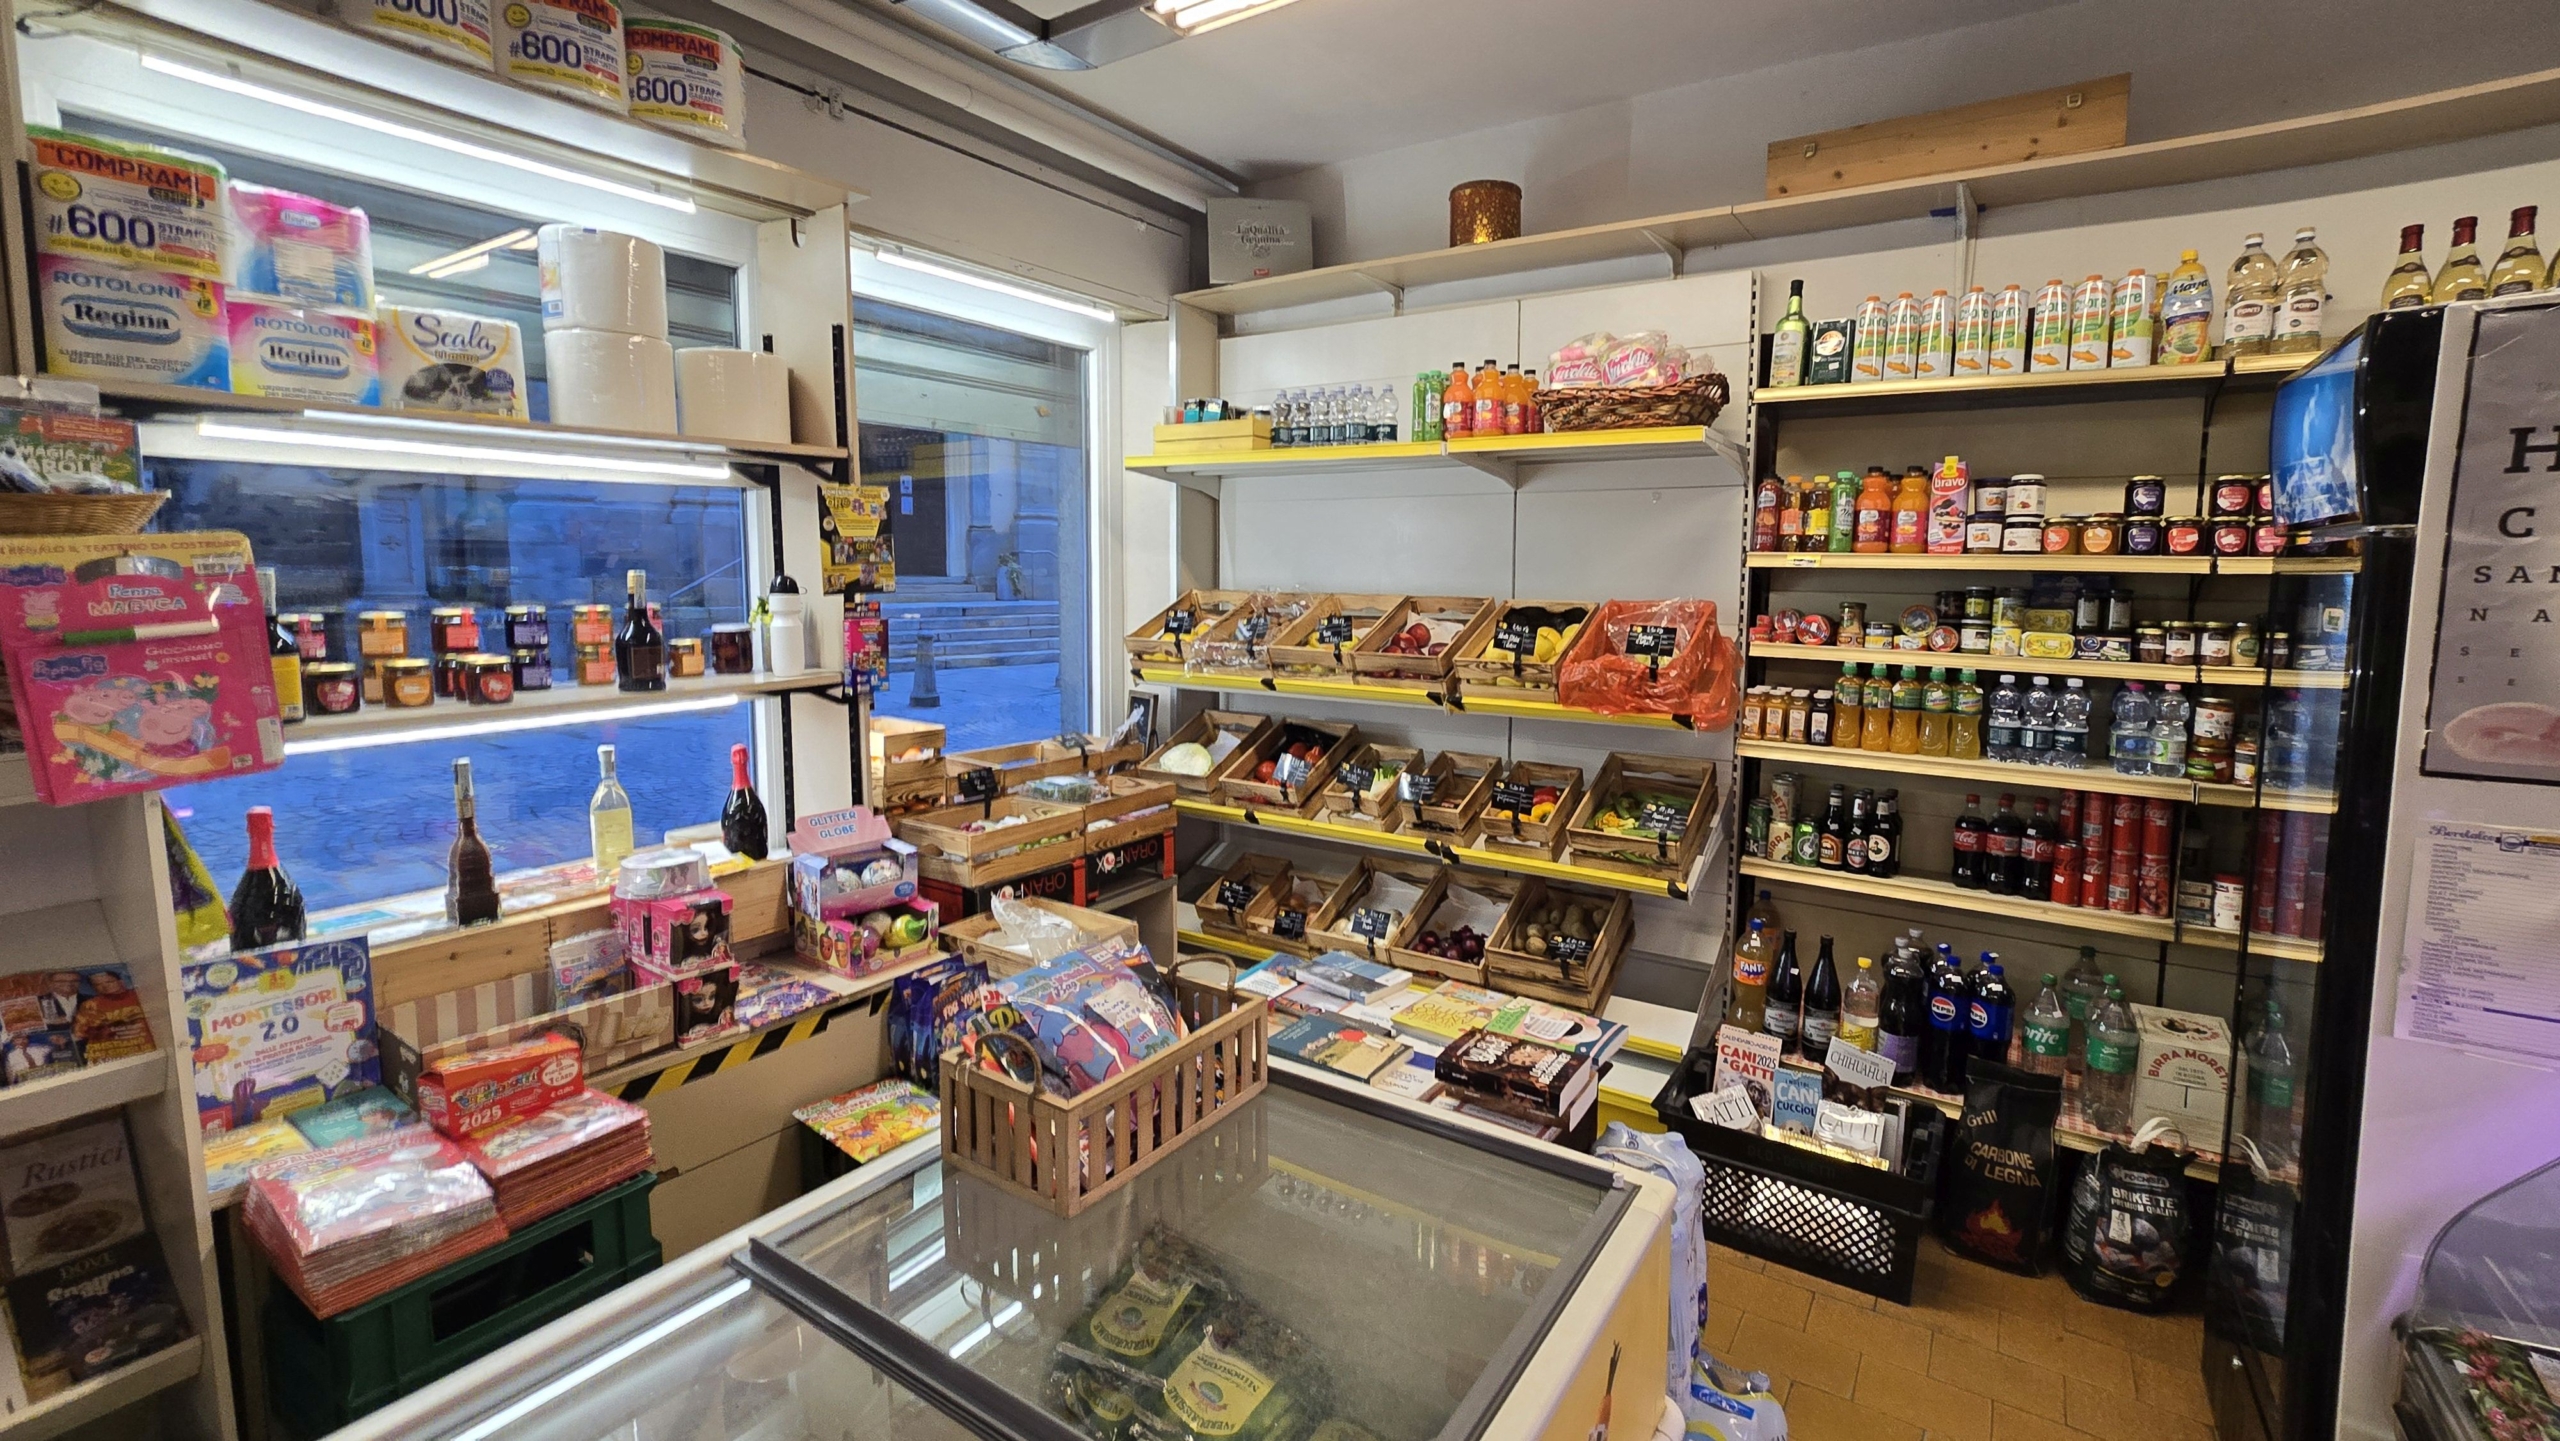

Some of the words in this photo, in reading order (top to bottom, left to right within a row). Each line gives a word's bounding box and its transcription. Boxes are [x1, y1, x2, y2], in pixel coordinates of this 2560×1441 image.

[53, 271, 183, 299] ROTOLONI
[74, 303, 171, 332] Regina
[2236, 306, 2262, 316] PONTI
[2292, 302, 2319, 312] PONTI
[253, 316, 353, 341] ROTOLONI
[412, 314, 497, 360] Scala
[269, 344, 341, 367] Regina
[1935, 476, 1966, 489] bravo
[109, 584, 163, 598] Penna
[88, 599, 187, 617] MAGICA
[32, 659, 82, 680] Peppa
[81, 656, 108, 676] Pig
[810, 810, 857, 827] GLITTER
[819, 824, 857, 839] GLOBE
[1767, 831, 1791, 858] BIRRA
[1052, 981, 1079, 999] Bag
[211, 987, 338, 1033] MONTESSORI
[1931, 1004, 1955, 1017] PEPSI
[258, 1016, 300, 1042] 2.0
[1720, 1044, 1757, 1065] CANI
[1757, 1054, 1777, 1070] 2025
[1830, 1050, 1889, 1084] CHIHUAHUA
[2148, 1050, 2182, 1078] BIRRA
[459, 1104, 502, 1133] 2025
[1818, 1112, 1878, 1144] GATTI
[1966, 1109, 1998, 1128] Grill
[22, 1146, 123, 1188] Rustici
[1970, 1141, 2036, 1171] CARBONE
[1964, 1156, 1978, 1171] DI
[1984, 1162, 2042, 1188] LEGNA
[2111, 1187, 2176, 1209] BRIKETTE
